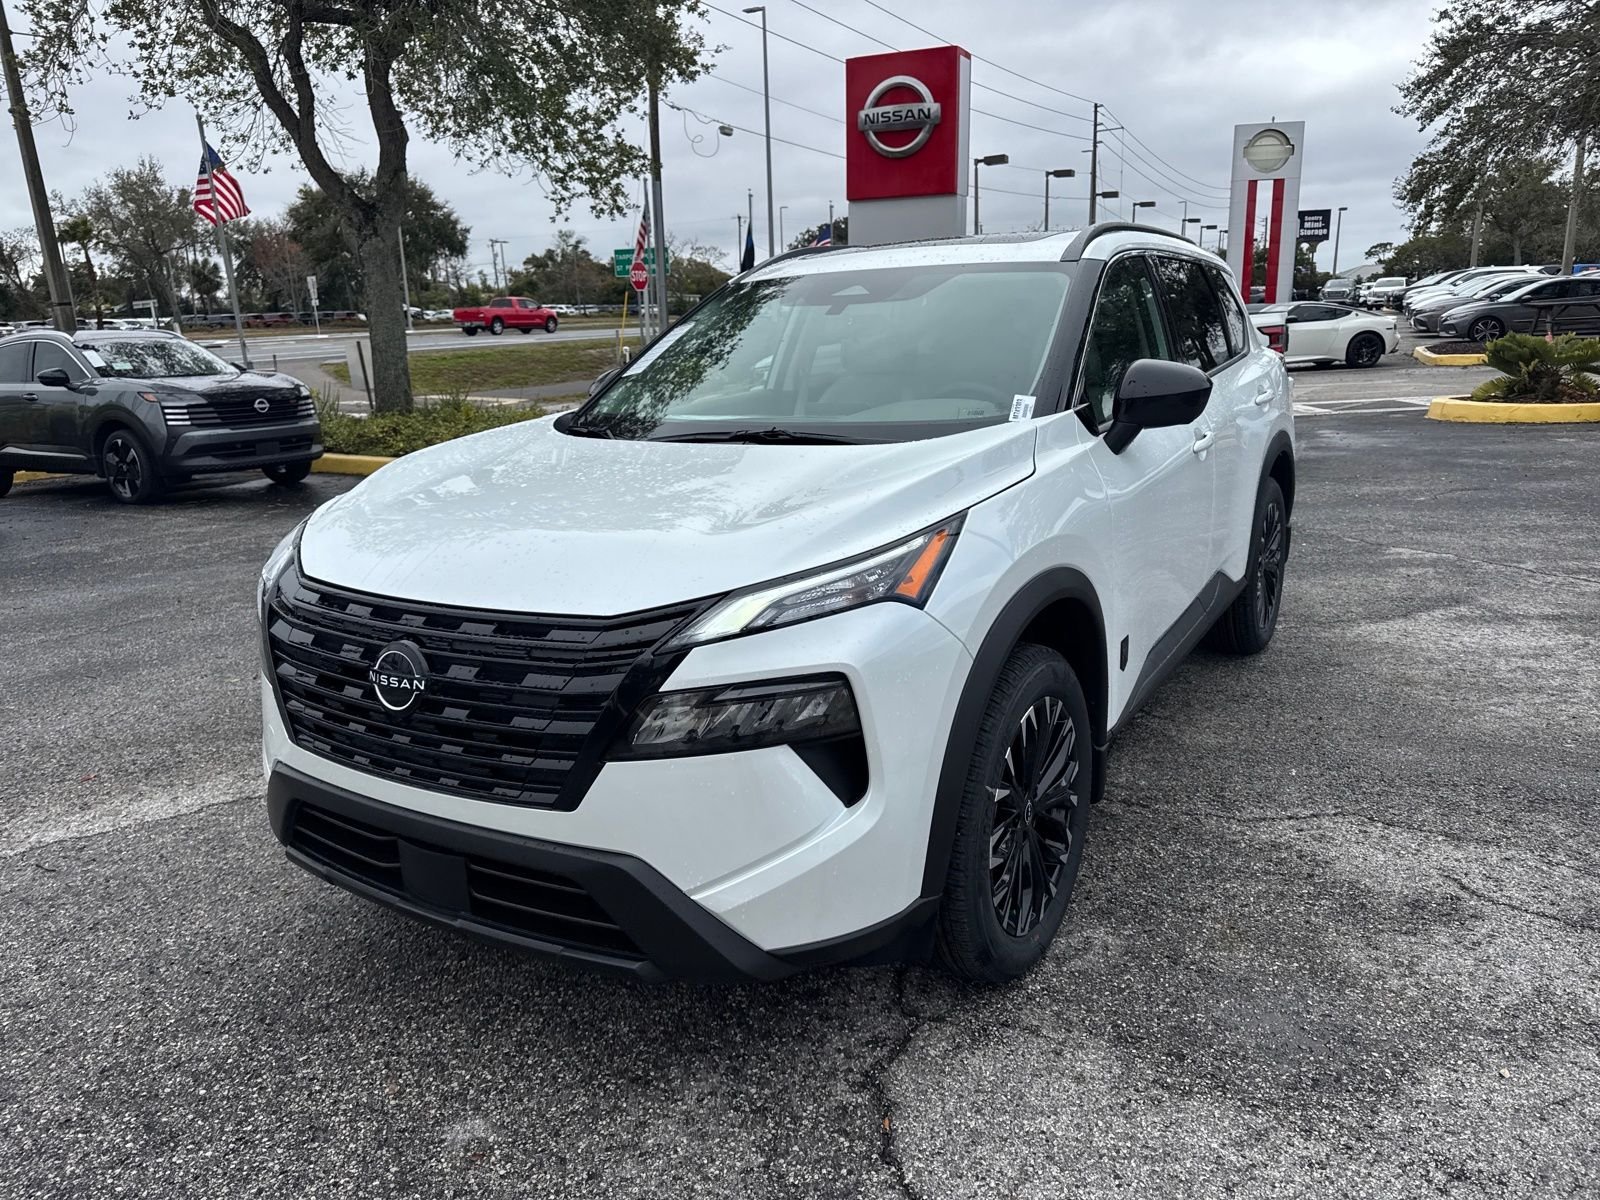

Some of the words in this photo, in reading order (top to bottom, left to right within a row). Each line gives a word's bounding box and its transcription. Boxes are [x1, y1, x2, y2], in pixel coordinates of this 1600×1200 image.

[864, 108, 931, 125] NISSAN
[632, 270, 647, 282] STOP
[369, 670, 425, 690] NISSAN
